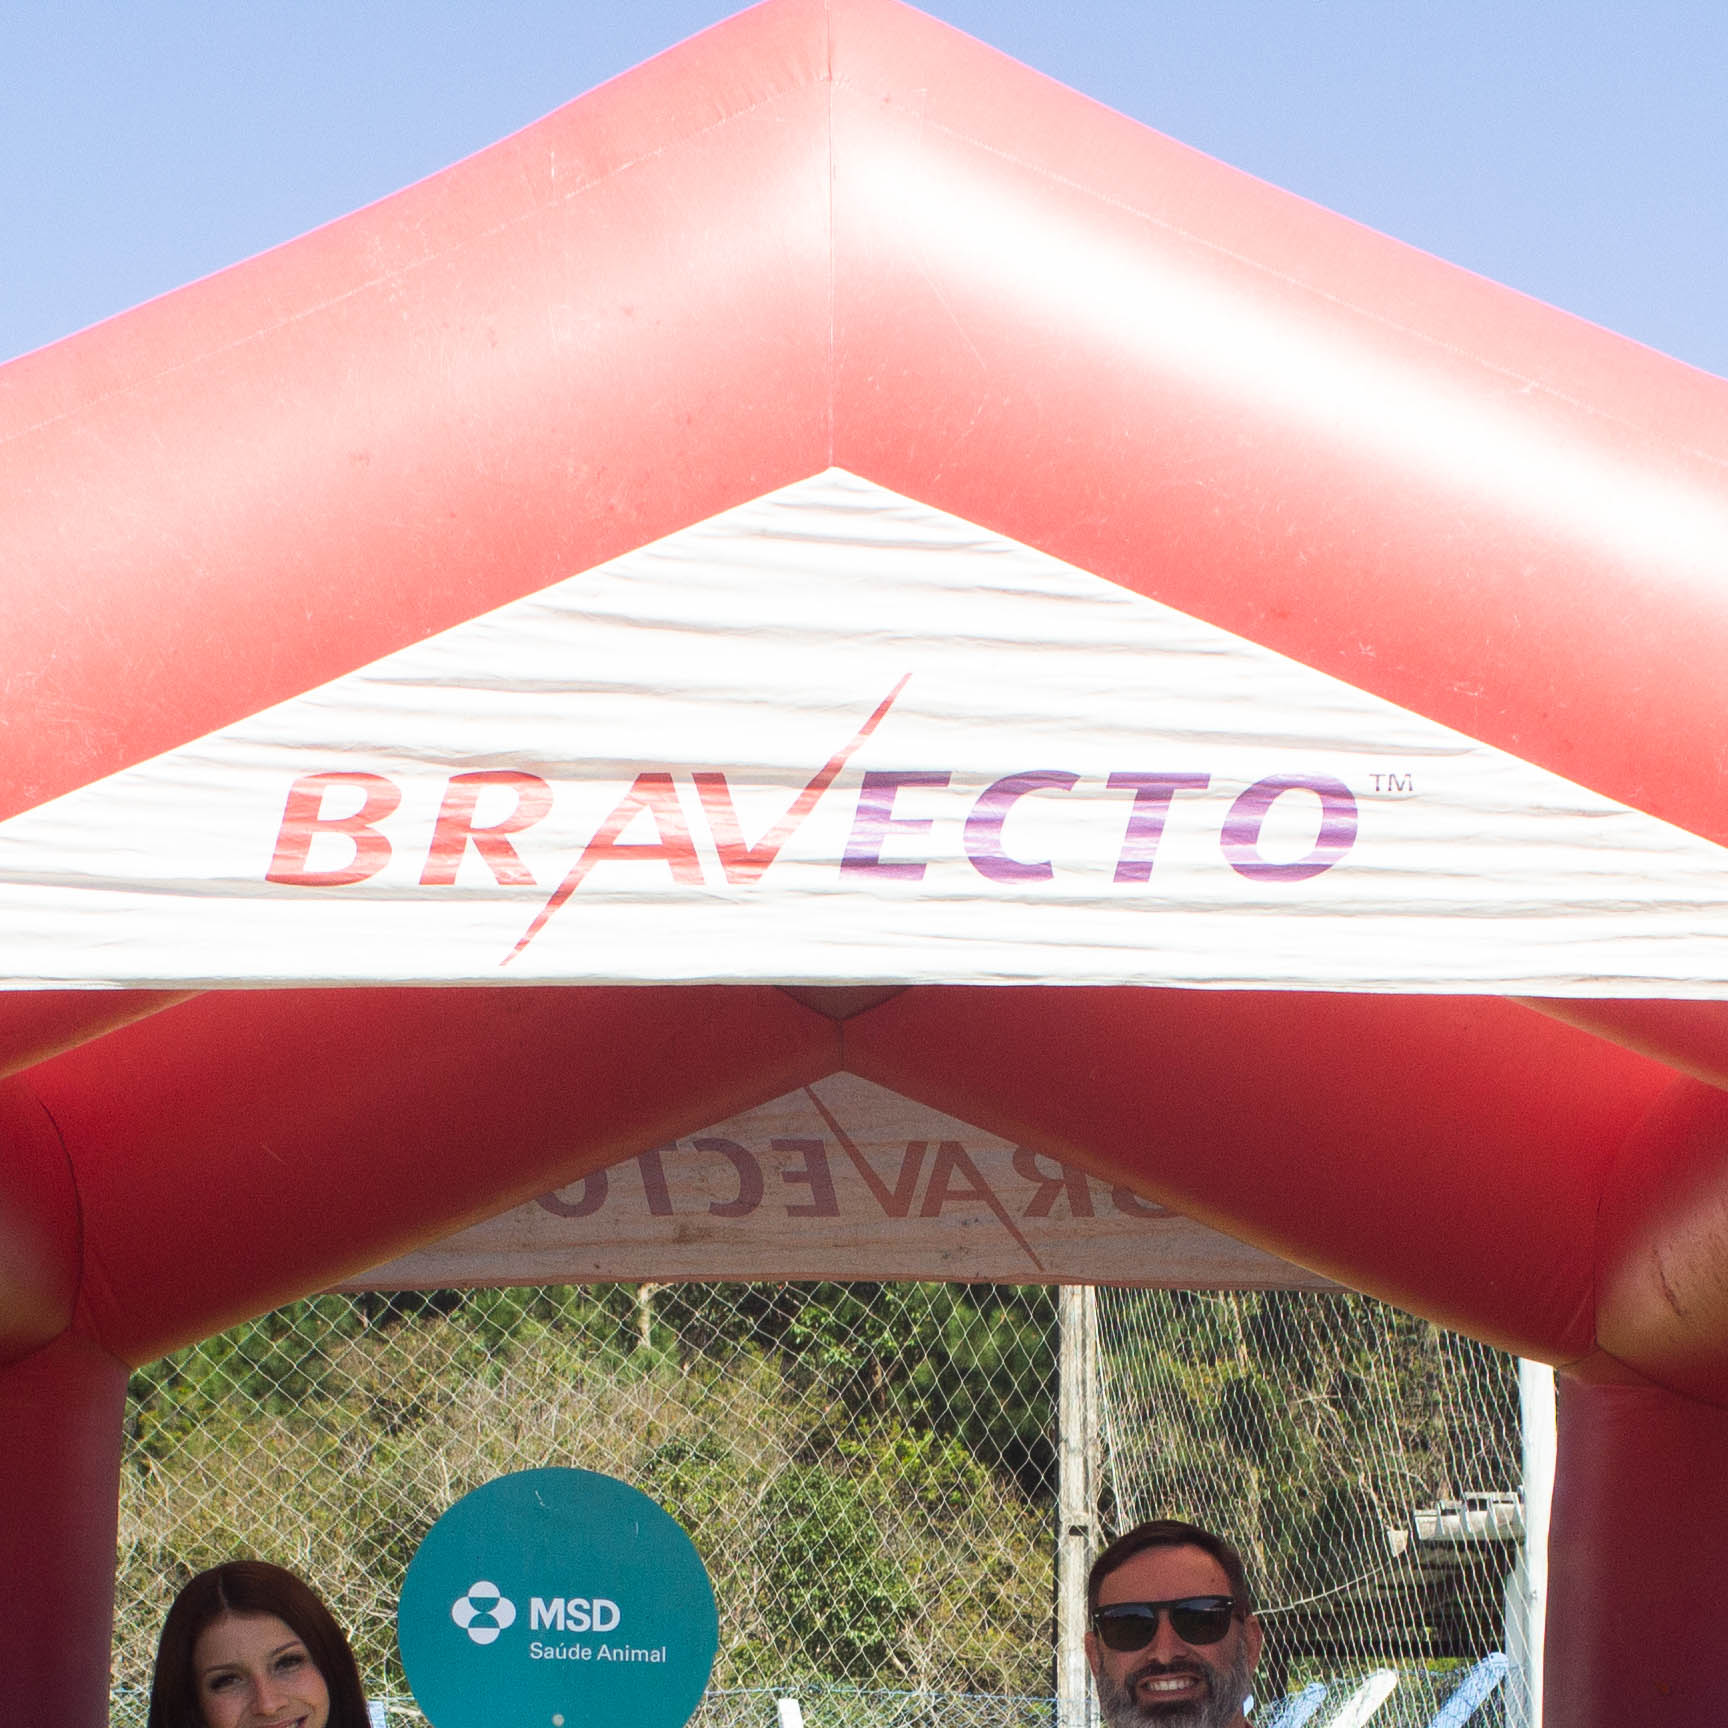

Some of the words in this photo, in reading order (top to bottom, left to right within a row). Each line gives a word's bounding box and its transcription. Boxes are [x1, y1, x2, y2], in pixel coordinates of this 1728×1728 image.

[265, 673, 1360, 966] BRAVECTO
[529, 1597, 621, 1632] MSD
[529, 1642, 592, 1661] Saúde
[596, 1644, 667, 1663] Animal
